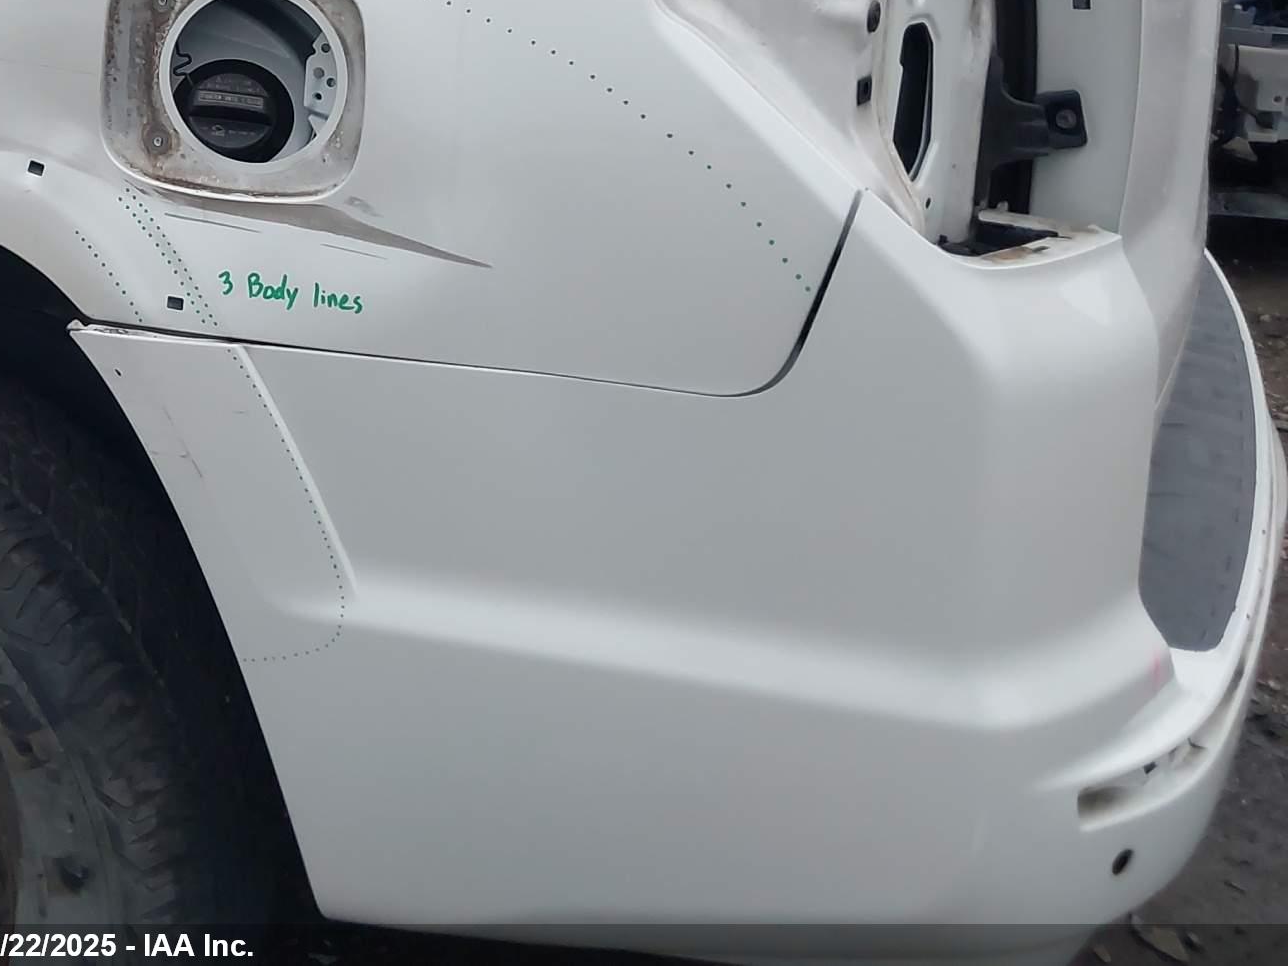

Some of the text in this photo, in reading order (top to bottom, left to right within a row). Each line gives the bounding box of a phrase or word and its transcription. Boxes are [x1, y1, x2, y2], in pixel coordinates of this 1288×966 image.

[218, 270, 363, 314] 3 Body lines
